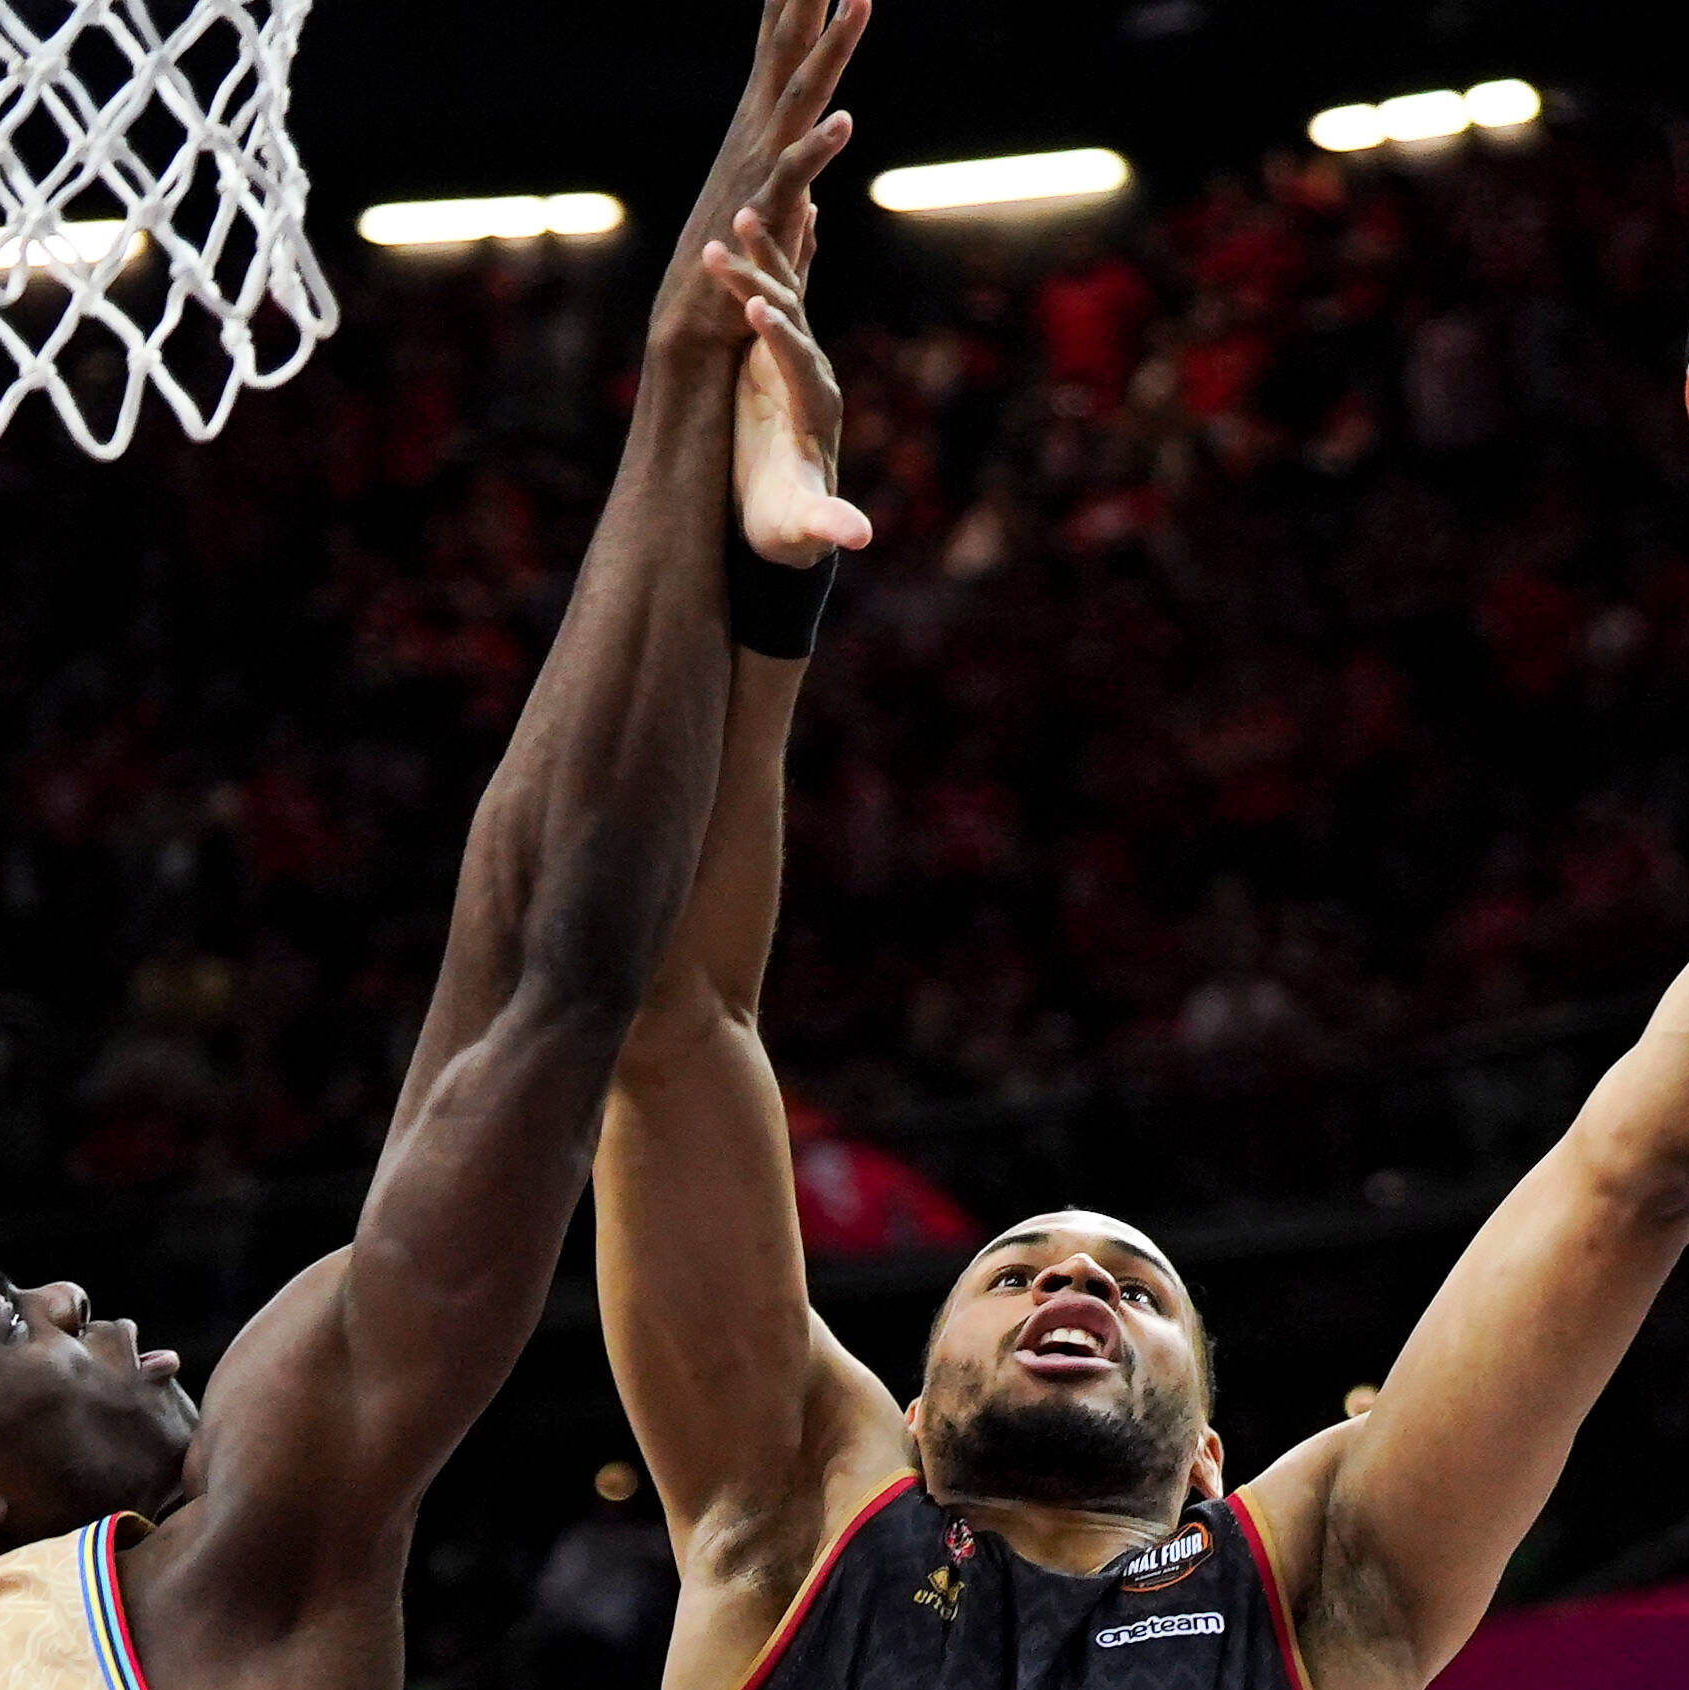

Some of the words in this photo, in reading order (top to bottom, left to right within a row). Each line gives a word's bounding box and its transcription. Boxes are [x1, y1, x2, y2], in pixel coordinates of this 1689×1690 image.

[1123, 1547, 1159, 1577] NAL
[1160, 1532, 1204, 1567] FOUR
[1097, 1613, 1224, 1646] oneteam
